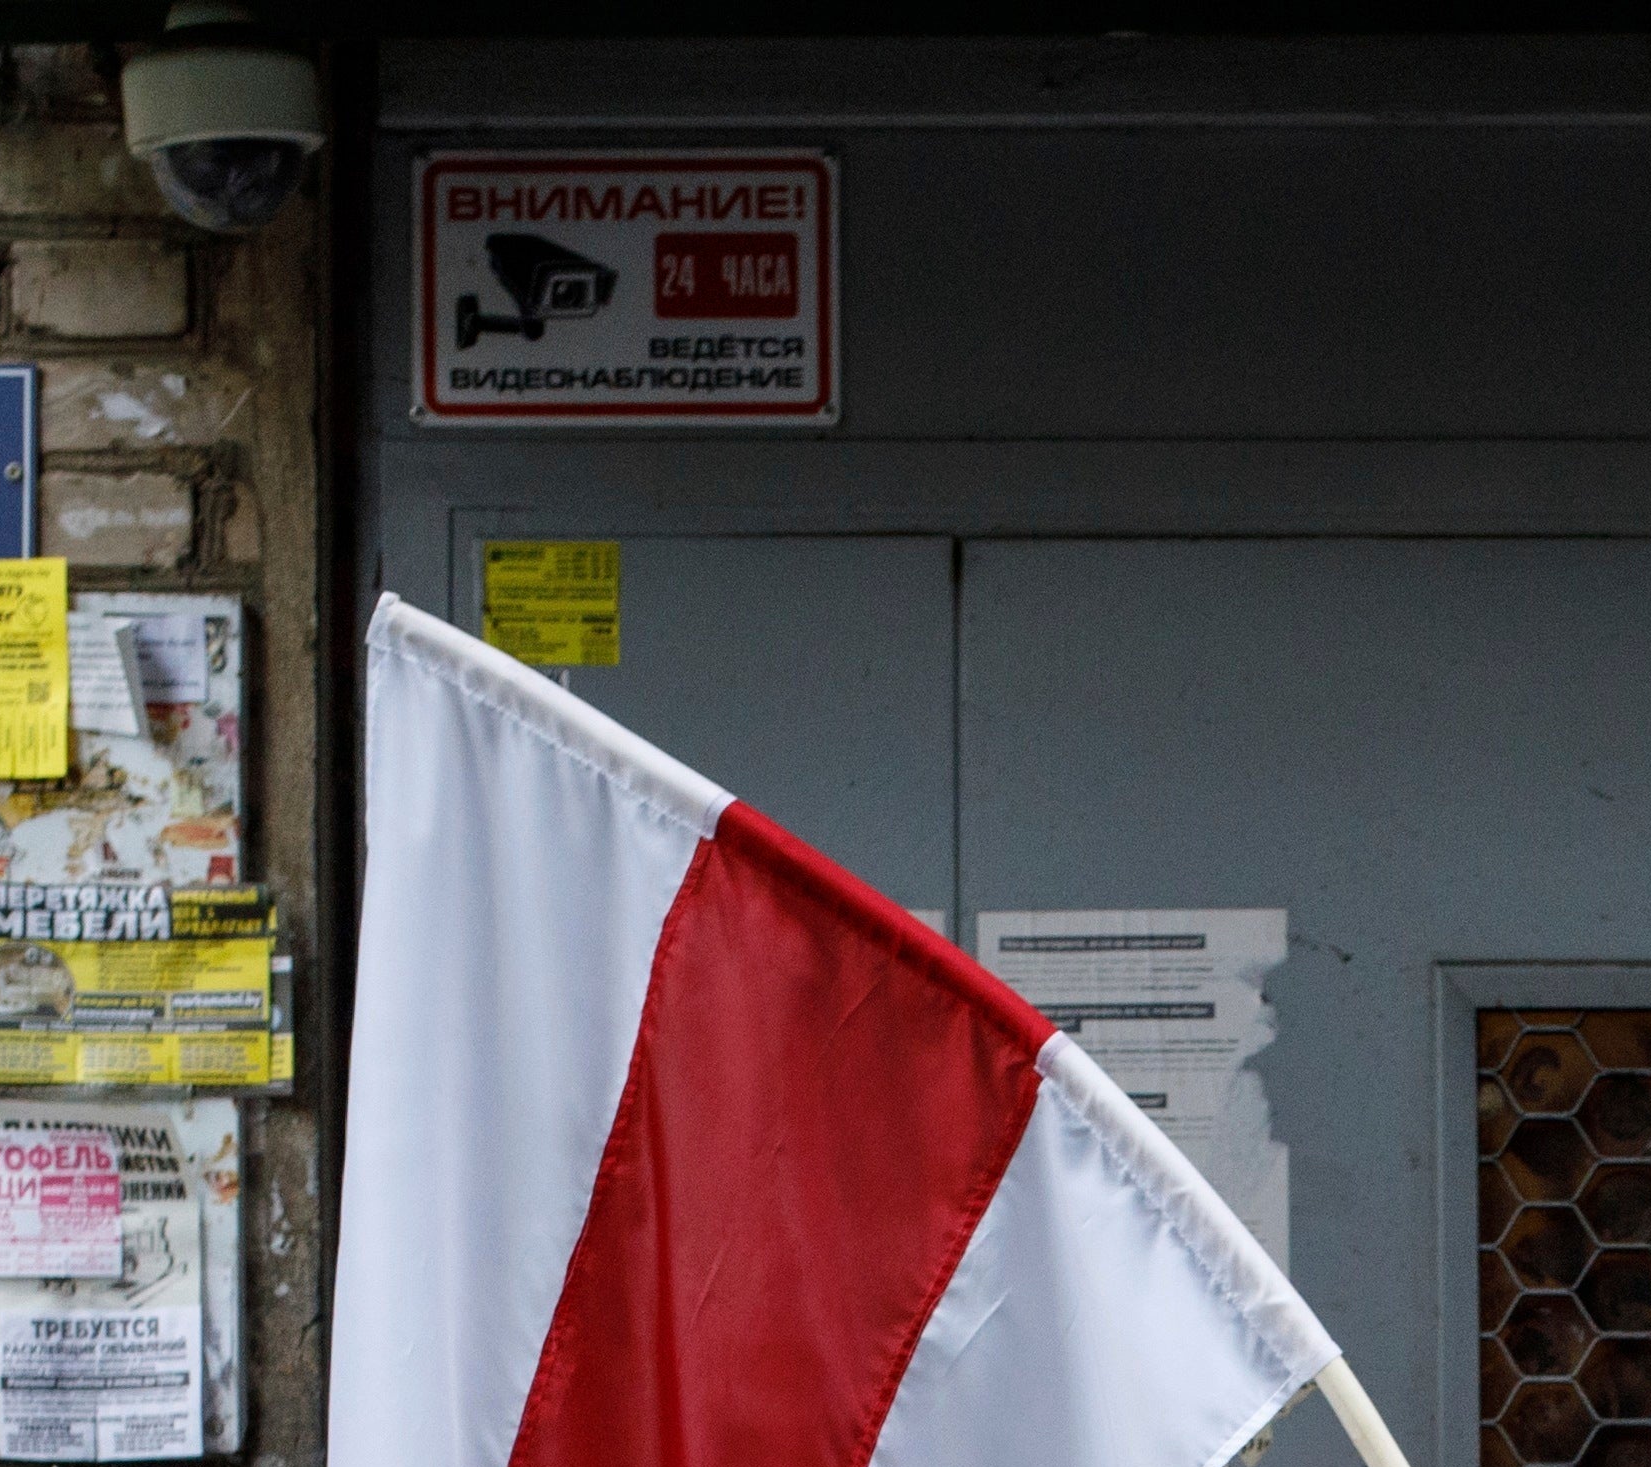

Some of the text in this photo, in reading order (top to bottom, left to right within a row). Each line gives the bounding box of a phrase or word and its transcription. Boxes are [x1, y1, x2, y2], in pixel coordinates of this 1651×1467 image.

[447, 185, 806, 222] ВНИМАНИЕ!
[661, 253, 791, 298] 24 ЧАСА
[649, 334, 806, 360] ВЕДЁТСЯ
[450, 367, 804, 393] ВИДЕОНАБЛЮДЕНИЕ
[31, 1316, 160, 1341] ТРЕБУЕТСЯ
